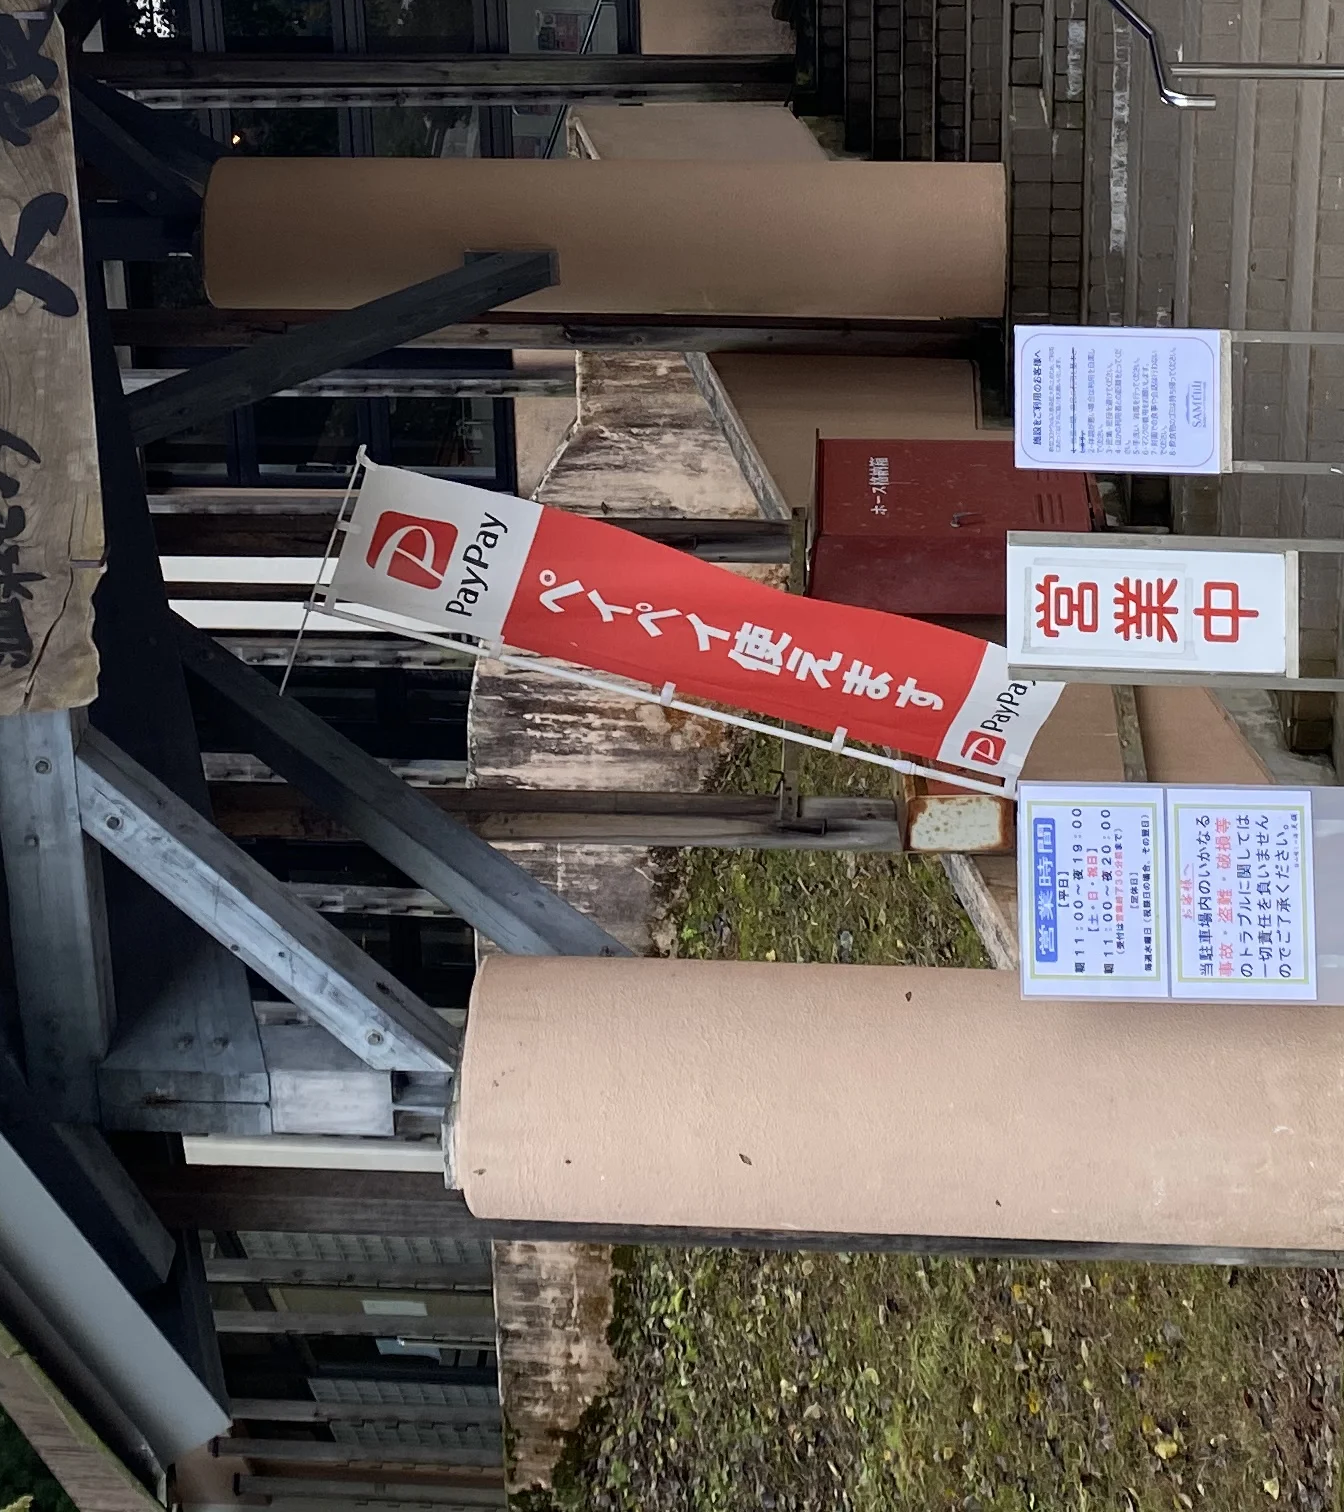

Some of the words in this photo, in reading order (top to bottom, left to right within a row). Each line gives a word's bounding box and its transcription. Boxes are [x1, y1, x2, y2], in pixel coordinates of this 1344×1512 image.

[1032, 349, 1042, 446] 施設をご利用のお客様へ
[444, 511, 508, 617] PayPay
[1034, 573, 1260, 644] 営業中
[537, 568, 945, 712] ペイペイ使えます
[979, 680, 1036, 732] PayPa
[1036, 823, 1055, 956] 営業時間
[1057, 871, 1070, 908] 【平日】
[1180, 864, 1192, 920] お客様へ
[1195, 814, 1214, 977] 当駐車場内のいかなる
[1214, 817, 1234, 977] 事故・盗難・破損等
[1236, 814, 1254, 978] のトラブルに関しては
[1255, 814, 1272, 978] 一切責任を負いません
[1274, 822, 1292, 978] のでご了承ください。
